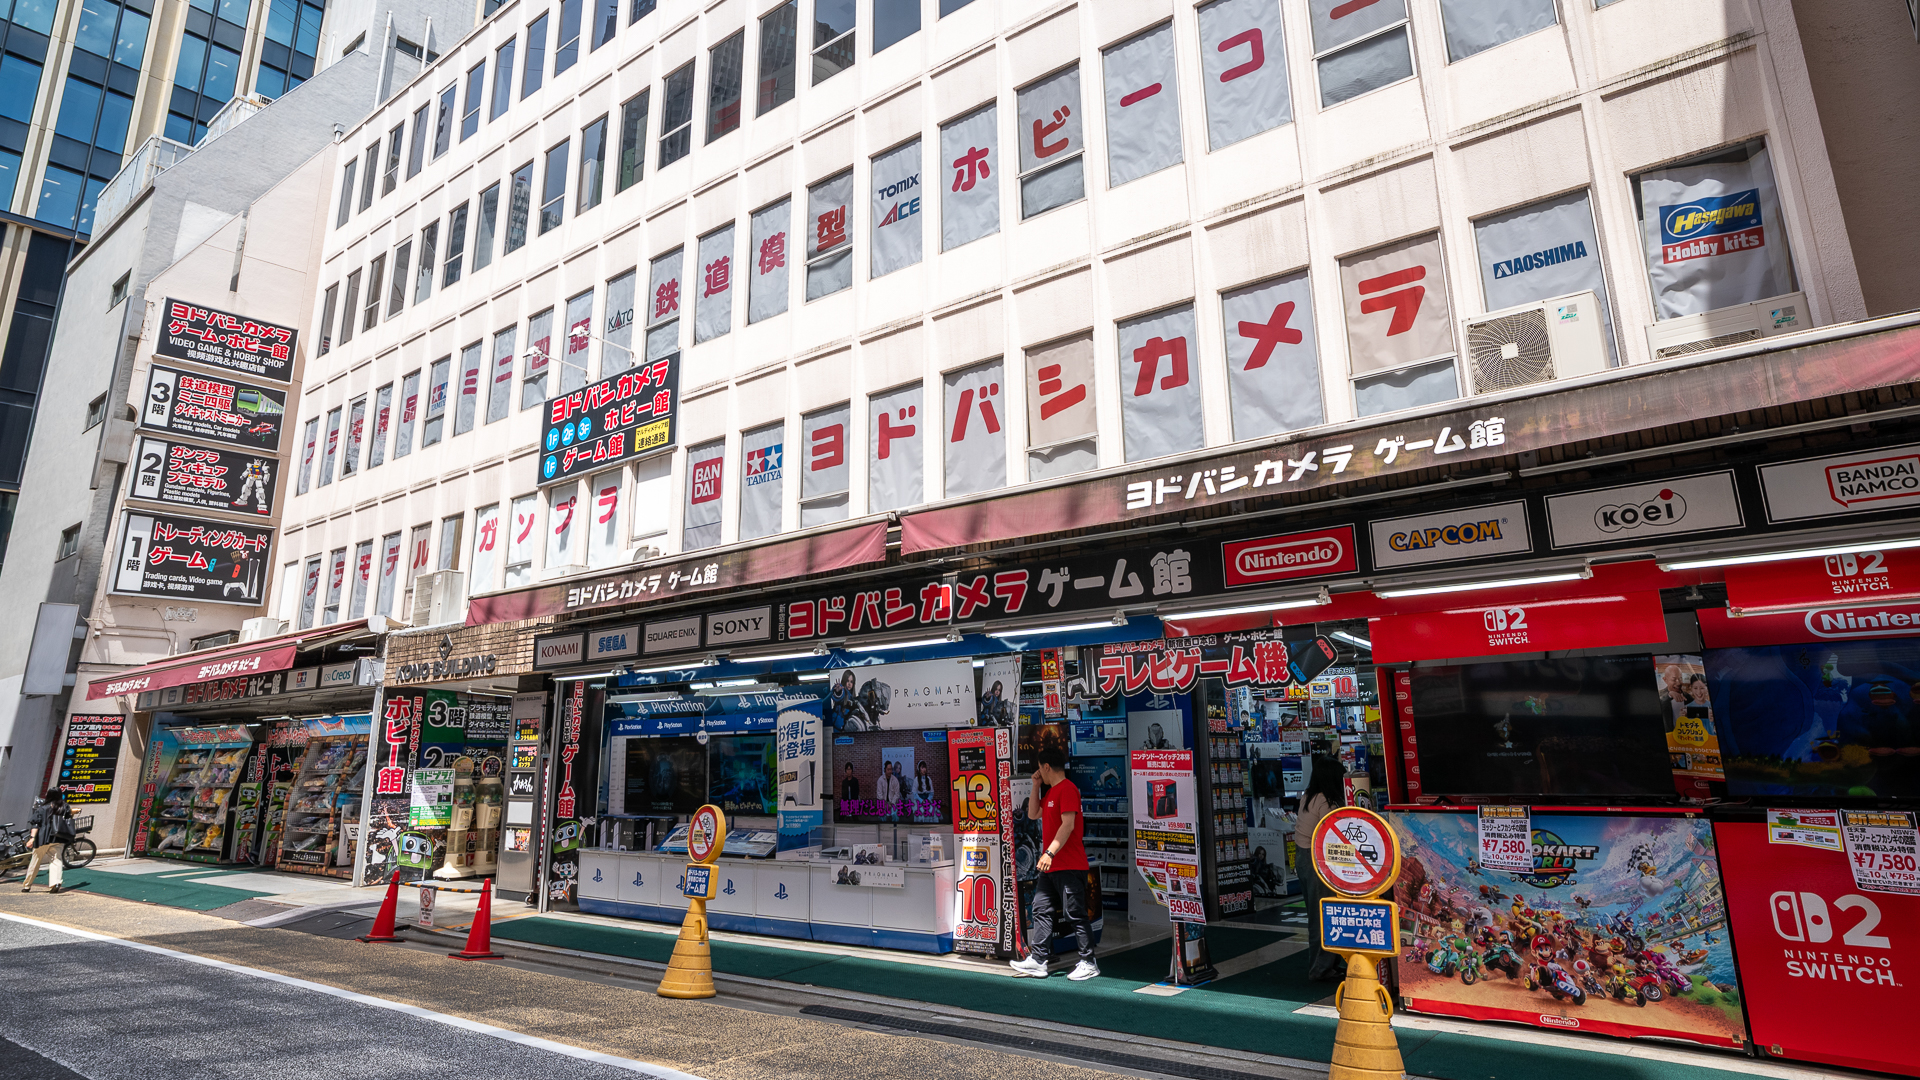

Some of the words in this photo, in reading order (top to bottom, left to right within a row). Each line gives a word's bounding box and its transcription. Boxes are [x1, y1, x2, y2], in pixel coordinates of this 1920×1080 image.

[878, 172, 919, 201] TOMIX
[878, 196, 920, 229] ACE
[1672, 200, 1755, 237] Hasegawa
[1513, 240, 1588, 275] AOSHIMA
[1667, 237, 1718, 262] Hobby
[1723, 233, 1760, 252] kits
[170, 302, 292, 343] ヨドバシカメラ
[607, 308, 634, 331] KATO
[168, 319, 290, 361] ゲーム・ホビー館
[169, 336, 195, 349] VIDEO
[197, 342, 223, 356] GAME
[224, 350, 231, 358] &
[233, 351, 261, 363] HOBBY
[262, 357, 285, 369] SHOP
[179, 376, 236, 398] 鉄道模型
[551, 359, 669, 424] ヨドバシカメラ
[178, 390, 232, 411] ミニ四駆
[174, 402, 251, 426] ダイキャストミニカー
[548, 433, 558, 446] 1F
[563, 428, 574, 442] 2F
[579, 422, 590, 436] 3F
[604, 388, 670, 431] ホビー館
[170, 445, 220, 463] ガンプラ
[546, 461, 556, 473] 1F
[563, 432, 625, 472] ゲーム館
[1126, 444, 1354, 510] ヨドバシカメラ
[1373, 416, 1505, 464] ゲーム館
[169, 458, 228, 477] フィギュア
[746, 470, 782, 487] TAMIYA
[1837, 462, 1915, 484] BANDAI
[167, 471, 227, 490] プラモデル
[1840, 476, 1918, 497] NAMCO
[153, 521, 268, 552] トレーディングカード
[1388, 518, 1502, 553] CAPCOM
[149, 545, 208, 570] ゲーム
[1244, 544, 1334, 572] Nintendo
[1859, 551, 1888, 574] 2
[144, 572, 168, 582] Trading
[168, 575, 187, 583] cards,
[189, 576, 205, 584] Video
[567, 575, 661, 608] ヨドバシカメラ
[668, 562, 719, 590] ゲーム館
[1832, 576, 1888, 586] NINTENDO
[1832, 582, 1890, 594] SWITCH
[788, 568, 1029, 639] ヨドバシカメラ
[1038, 549, 1192, 606] ゲーム館
[713, 617, 763, 636] SONY
[1508, 607, 1528, 630] 2
[598, 633, 627, 653] SEGA
[647, 630, 678, 642] SQUARE
[1104, 640, 1165, 654] ヨドバシカメラ
[1167, 636, 1216, 650] 新宿西口本店
[1223, 629, 1283, 644] ゲーム・ホビー館
[1488, 631, 1527, 639] NINTENDO
[1488, 636, 1528, 647] SWITCH
[541, 642, 579, 658] KONAMI
[198, 660, 238, 679] ヨドバシカメラ
[331, 670, 351, 680] Creos
[395, 662, 430, 681] KONO
[432, 654, 496, 676] BUILDING
[1099, 641, 1290, 692] テレビゲーム機
[186, 677, 248, 703] ヨドバシカメラ
[248, 673, 281, 697] ホビー館
[894, 684, 972, 698] PRAGMATA
[428, 700, 465, 728] 3階
[571, 680, 584, 743] ヨドバシカメラ
[651, 700, 705, 713] PlayStation
[409, 696, 423, 752] ヨドバシカメラ
[778, 720, 816, 743] お得に
[67, 737, 106, 746] ホビー館
[377, 696, 411, 794] ホビー館
[60, 784, 95, 792] ゲーム館
[557, 744, 579, 818] ゲーム館
[840, 799, 942, 817] 無理だと思いますよまだ
[1483, 807, 1525, 818] 新製品
[958, 819, 997, 831] ポイント還元
[1847, 813, 1911, 828] 新製品
[1854, 844, 1916, 854] 消費税込み特価
[688, 869, 709, 877] ヨドバシカメラ
[1853, 852, 1916, 872] ¥7,580
[686, 884, 706, 894] ゲーム館
[1326, 906, 1386, 918] ヨドバシカメラ
[1331, 916, 1382, 928] 新宿西口本店
[1833, 893, 1891, 949] 2
[956, 924, 997, 940] ポイント還元
[1329, 927, 1385, 946] ゲーム館
[1784, 949, 1891, 968] NINTENDO
[1786, 960, 1896, 987] SWITCH
[1542, 1015, 1577, 1027] Nintendo
